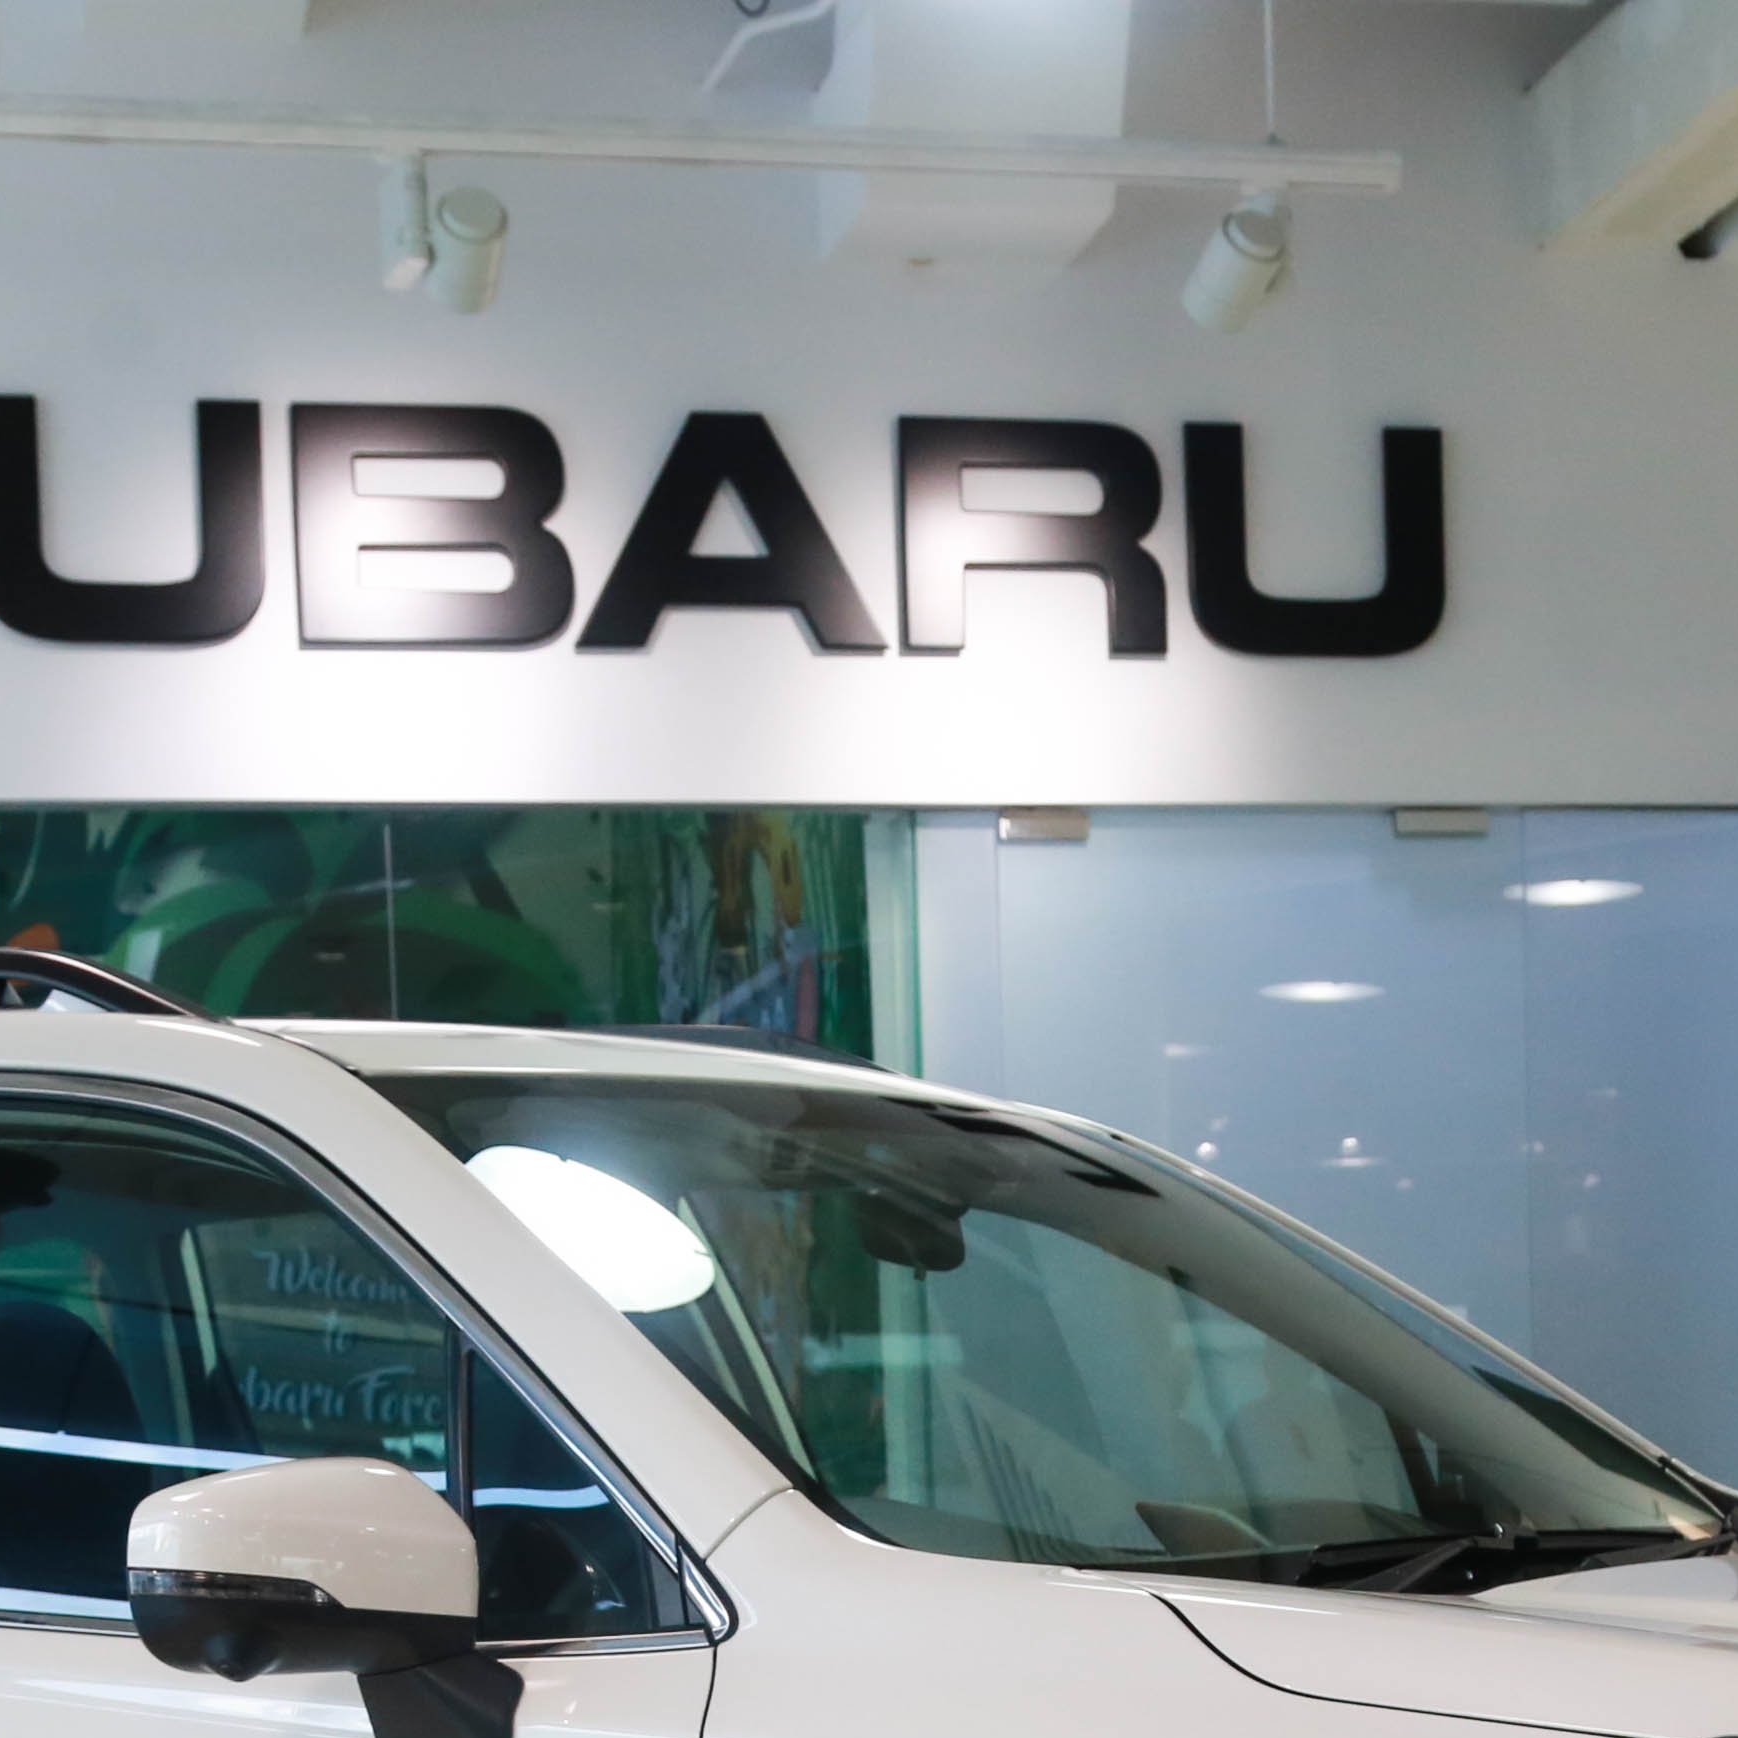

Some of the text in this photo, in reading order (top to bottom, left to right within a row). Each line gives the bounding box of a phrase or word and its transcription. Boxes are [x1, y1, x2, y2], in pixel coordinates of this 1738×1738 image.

[252, 1246, 409, 1301] Welcom
[239, 1364, 444, 1425] baru Fore
